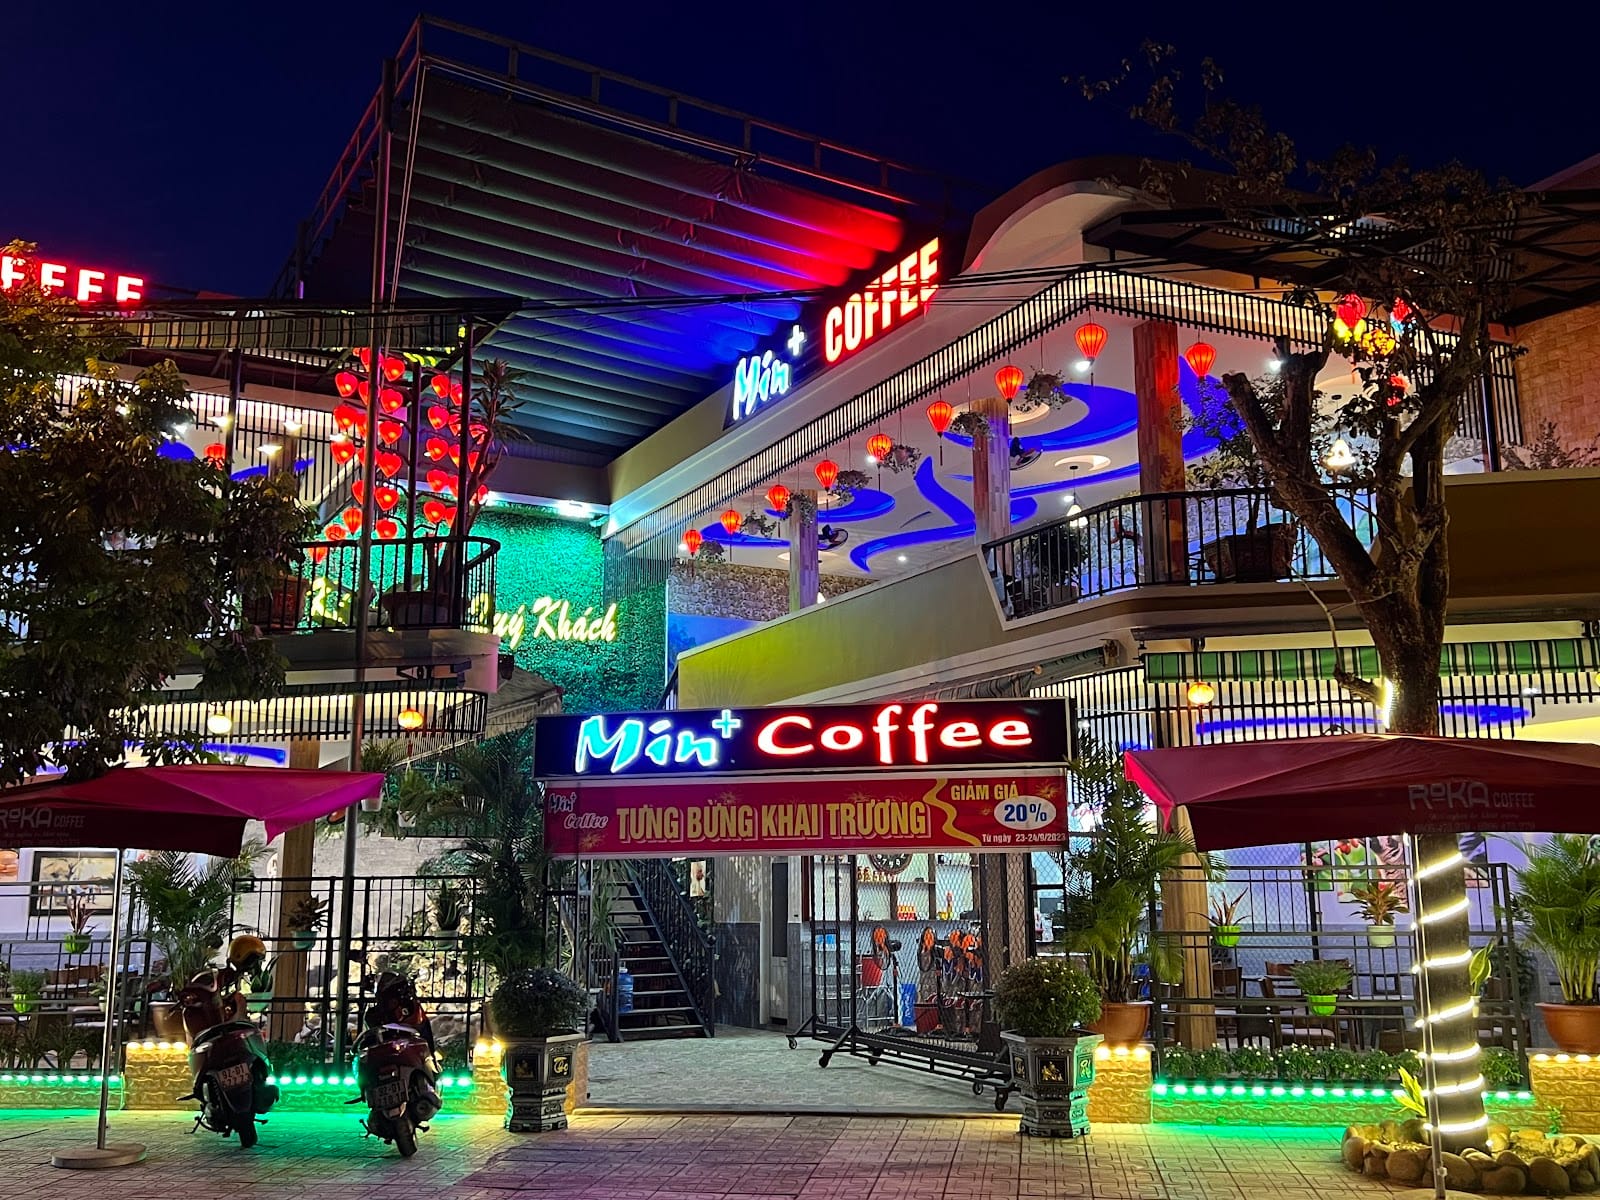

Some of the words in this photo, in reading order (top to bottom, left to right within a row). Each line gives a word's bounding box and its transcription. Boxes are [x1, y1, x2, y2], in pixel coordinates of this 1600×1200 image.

[825, 237, 939, 362] COFFEE
[533, 597, 617, 642] Khách
[756, 703, 1033, 765] Coffee
[951, 779, 990, 801] GIẢM
[994, 780, 1019, 801] GIÁ
[1493, 792, 1536, 808] COFFEE
[563, 812, 609, 830] Coffee
[617, 804, 682, 843] TƯNG
[687, 799, 757, 842] BỪNG
[761, 803, 823, 840] KHAI
[826, 799, 931, 839] TRƯƠNG
[1003, 803, 1048, 823] 20%
